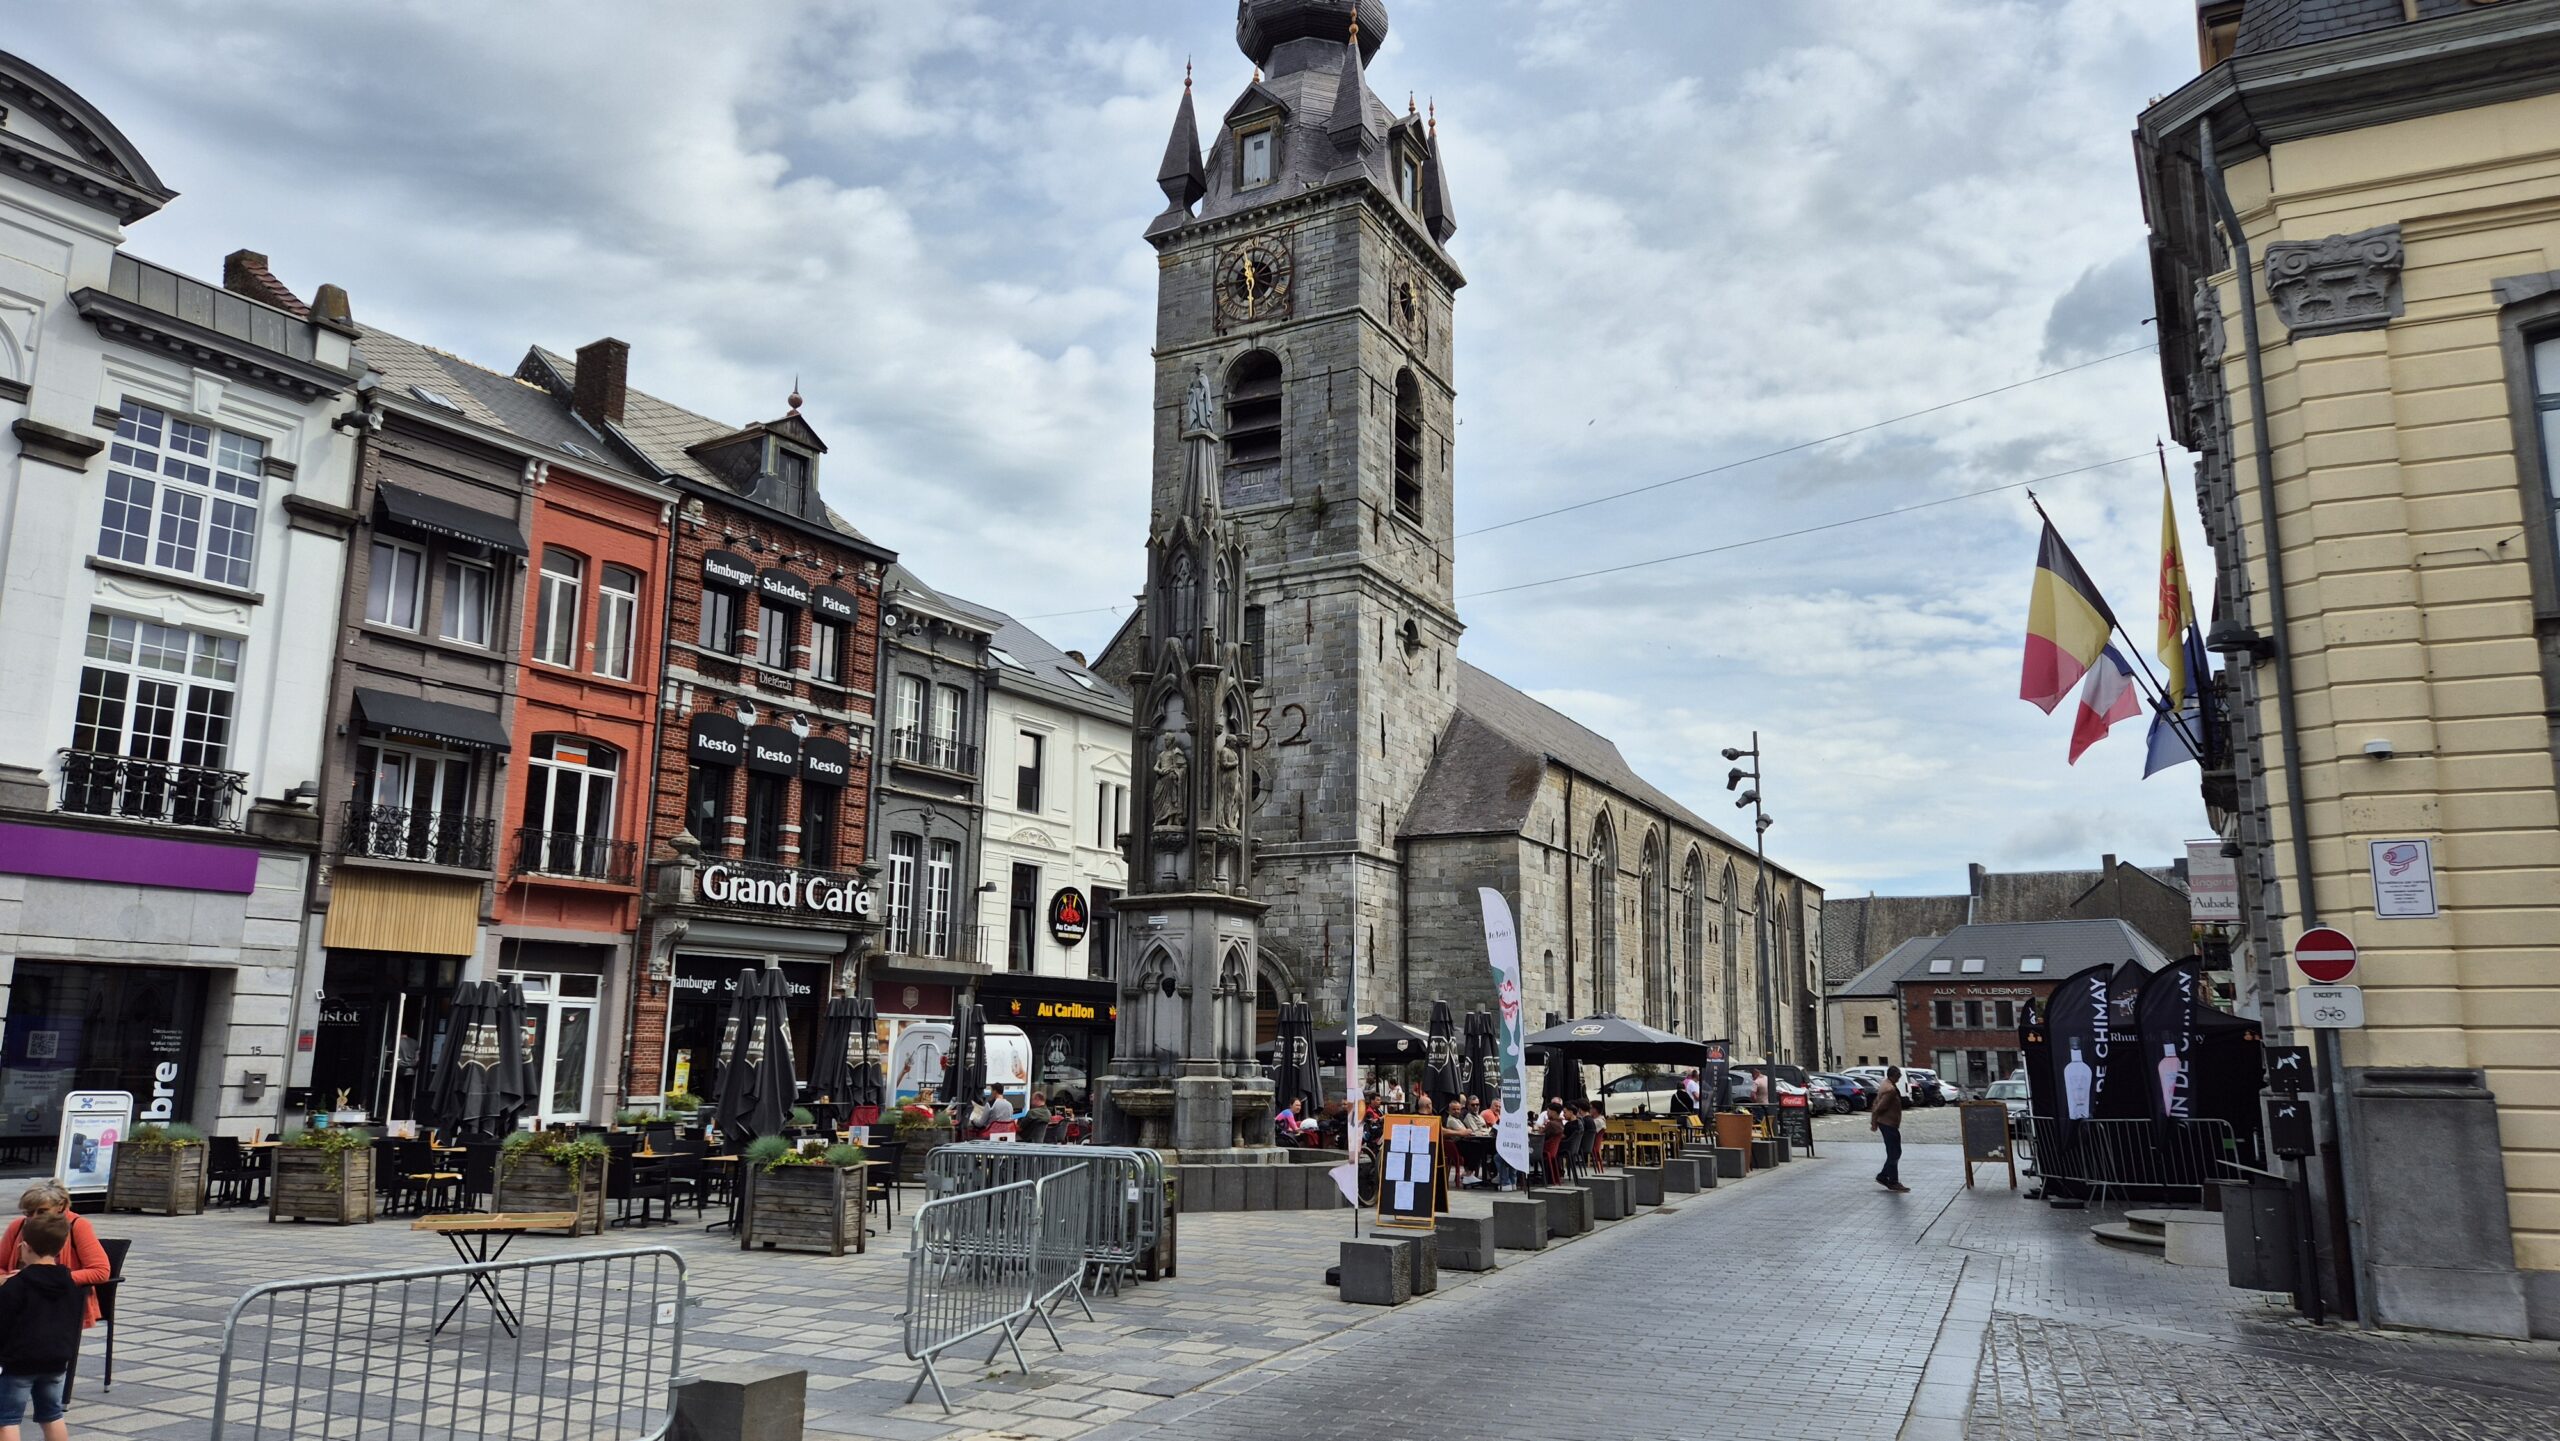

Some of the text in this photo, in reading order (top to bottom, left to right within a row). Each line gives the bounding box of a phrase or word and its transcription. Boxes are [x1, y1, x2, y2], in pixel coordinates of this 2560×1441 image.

[412, 519, 508, 551] Bistrot Restaurant
[706, 558, 753, 586] Hamburger
[763, 577, 807, 601] Salades
[822, 595, 850, 615] Pâtes
[391, 726, 491, 750] Bistrot Restaurant
[698, 734, 737, 754] Resto
[756, 746, 792, 764] Resto
[809, 757, 843, 775] Resto
[702, 865, 871, 915] Grand Café
[2193, 896, 2235, 909] Aubade
[1933, 987, 1957, 995] AUX
[1037, 1003, 1094, 1018] Au Carillon
[2089, 977, 2109, 1058] CHIMAY
[250, 1046, 262, 1055] 15
[2174, 1060, 2189, 1088] DE
